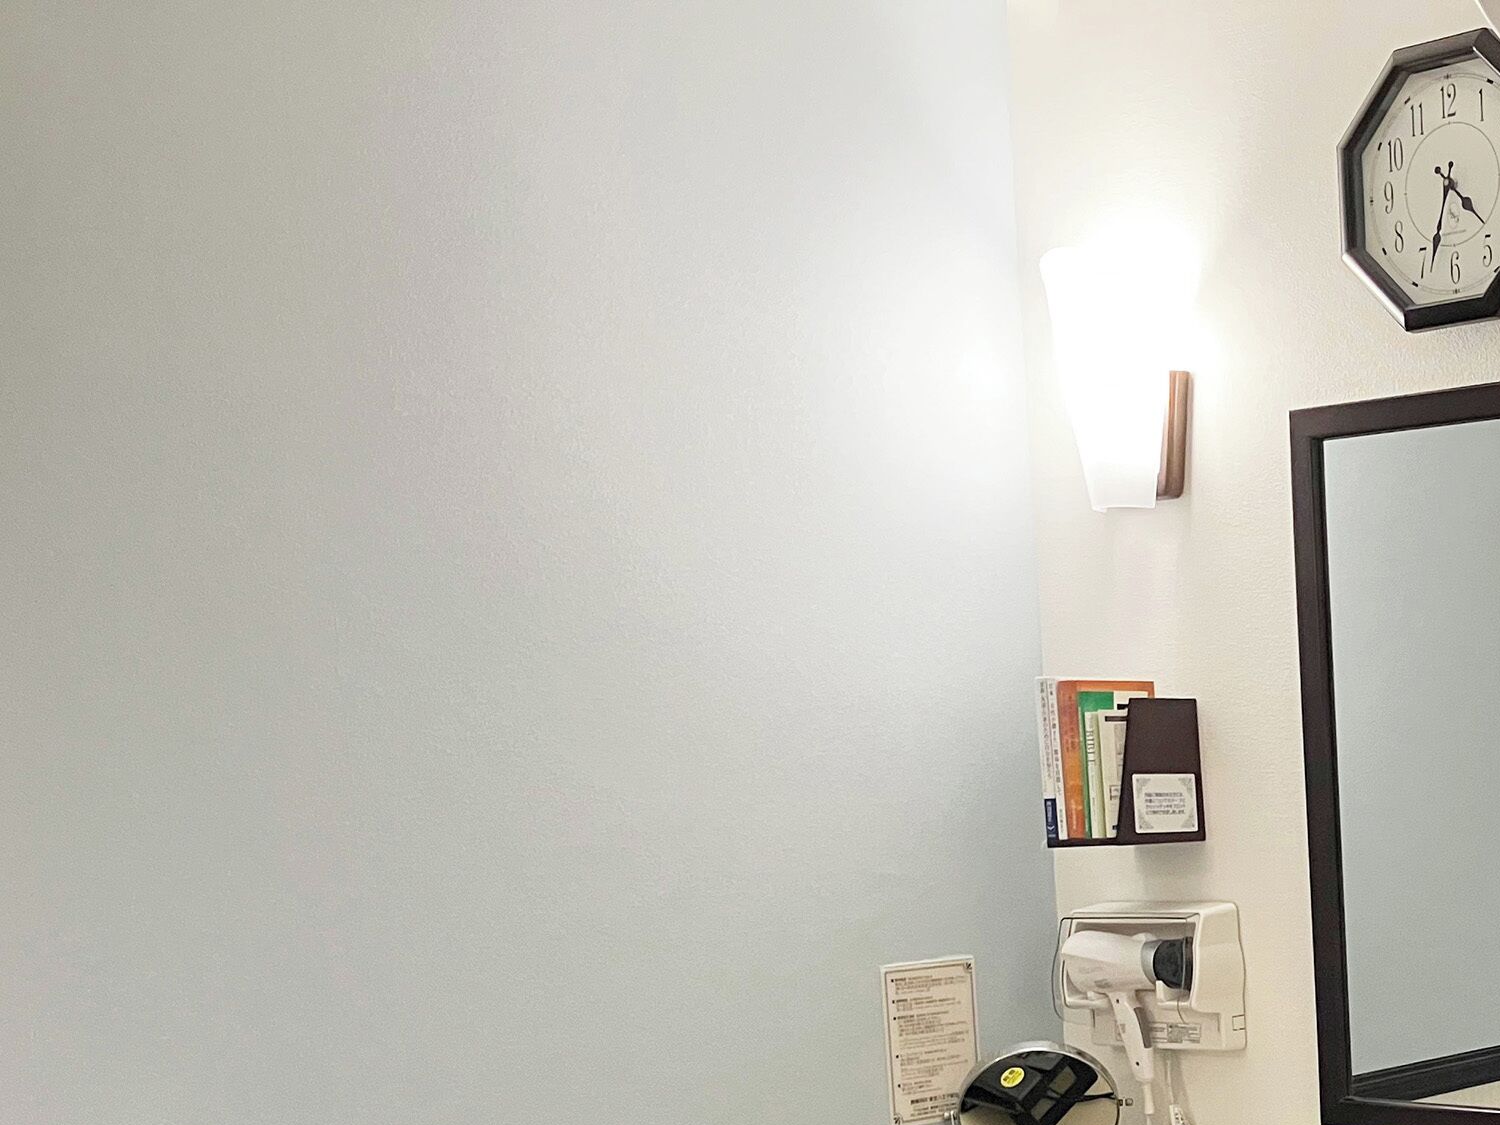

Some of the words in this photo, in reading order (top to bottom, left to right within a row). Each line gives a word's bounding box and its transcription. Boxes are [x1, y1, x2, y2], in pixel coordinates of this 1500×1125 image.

[1440, 83, 1457, 119] 12
[1478, 88, 1485, 122] 1
[1410, 103, 1424, 137] 11
[1388, 137, 1403, 172] 10
[1384, 181, 1394, 215] 9
[1394, 221, 1404, 253] 8
[1482, 234, 1493, 267] 5
[1419, 247, 1427, 279] 7
[1450, 251, 1461, 285] 6
